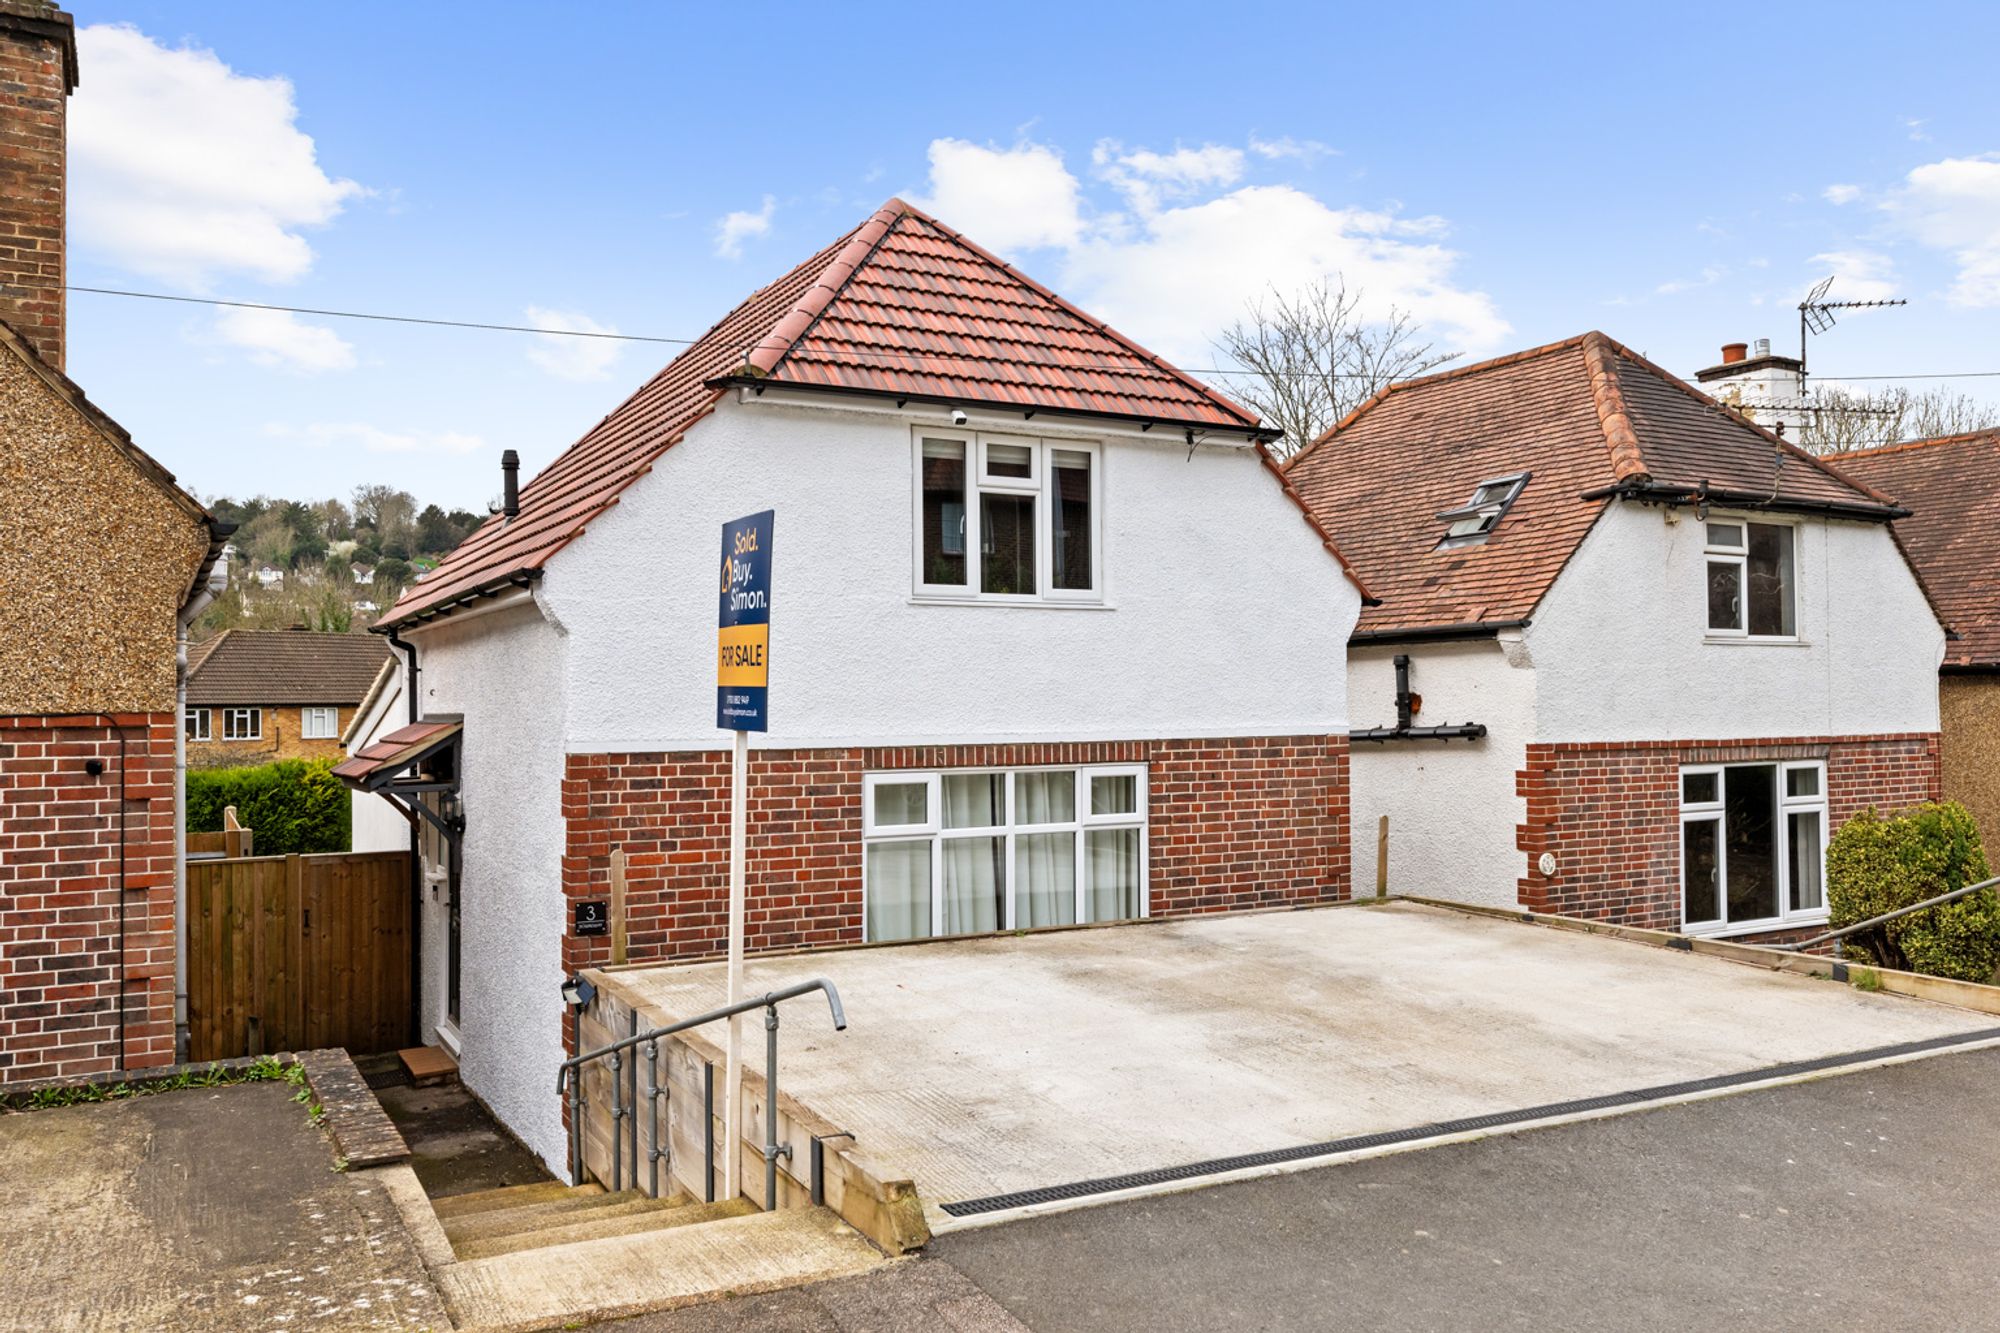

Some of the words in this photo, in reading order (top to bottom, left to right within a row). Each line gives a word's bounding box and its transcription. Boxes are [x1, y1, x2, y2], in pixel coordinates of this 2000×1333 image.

[734, 527, 758, 555] Sold.
[732, 559, 753, 587] Buy.
[730, 587, 767, 612] Simon.
[721, 645, 734, 668] FOR
[735, 644, 762, 667] SALE
[586, 905, 596, 921] 3
